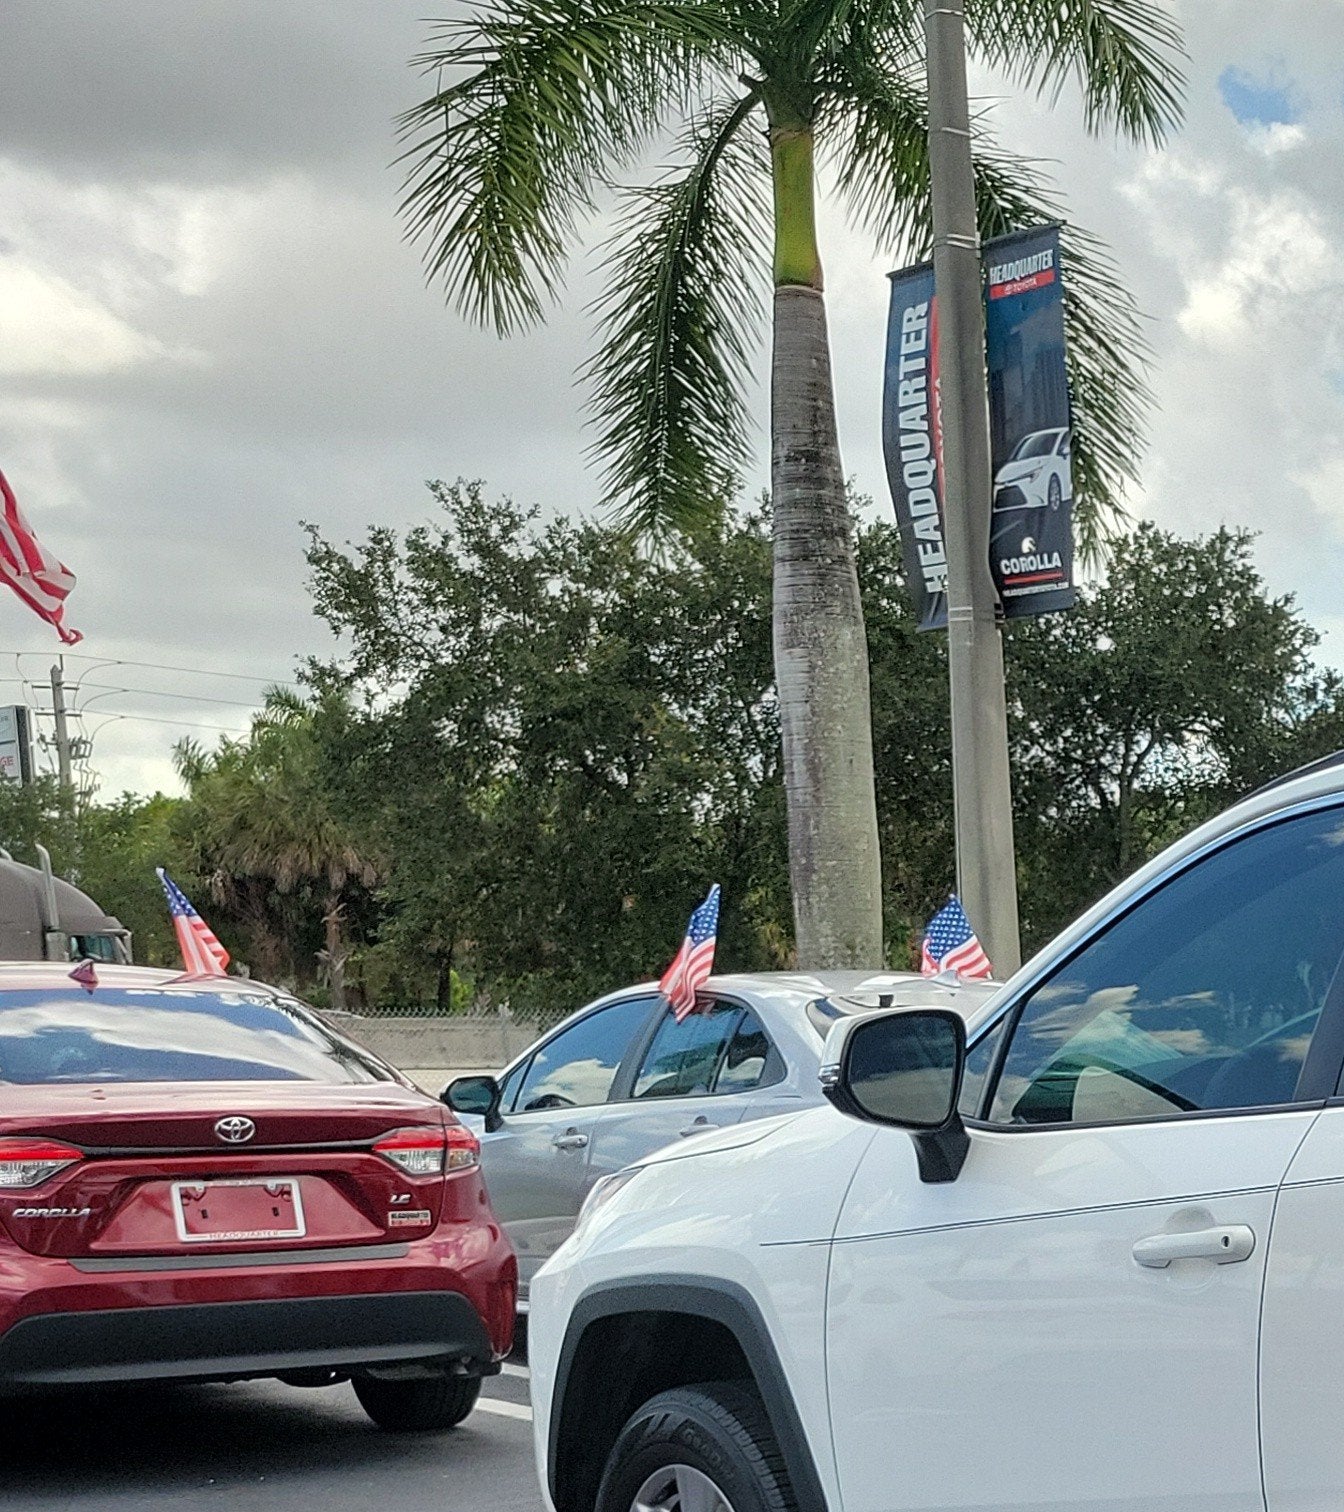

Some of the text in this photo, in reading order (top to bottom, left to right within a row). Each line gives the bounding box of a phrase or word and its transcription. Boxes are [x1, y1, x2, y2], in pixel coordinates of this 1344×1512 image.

[898, 301, 948, 594] HEADQUARTER
[1000, 552, 1062, 575] COROLLA
[390, 1194, 411, 1204] LE
[12, 1208, 91, 1218] COROLLA
